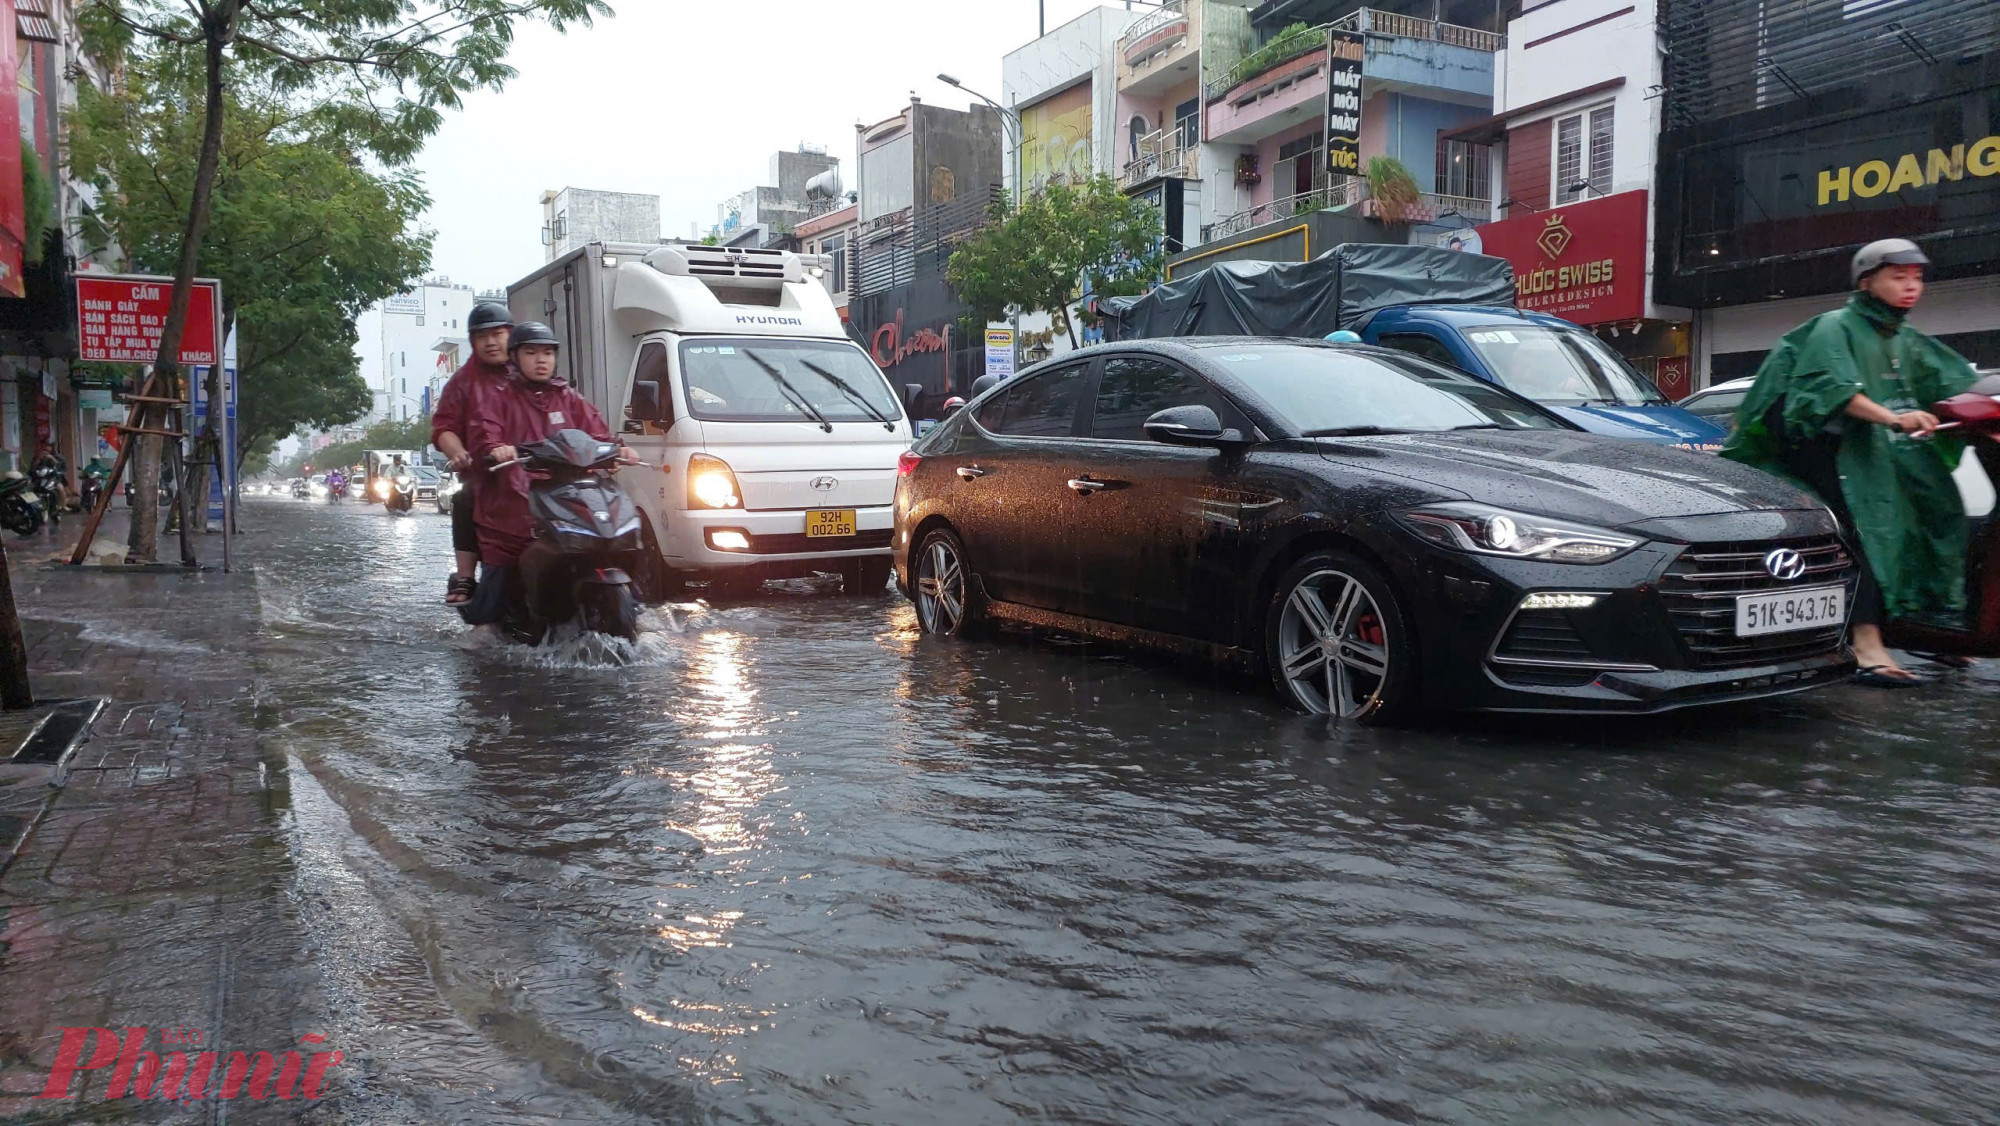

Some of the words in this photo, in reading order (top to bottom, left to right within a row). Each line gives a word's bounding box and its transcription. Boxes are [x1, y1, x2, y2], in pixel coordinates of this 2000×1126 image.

[1333, 65, 1361, 88] MẮT
[1333, 91, 1359, 111] MÔI
[1331, 112, 1359, 132] MÀY
[1330, 146, 1357, 169] TÓC
[1817, 136, 2000, 206] HOANG
[1559, 259, 1613, 288] SWISS
[132, 283, 160, 300] CẤM
[111, 313, 135, 324] SÁCH
[140, 314, 158, 325] BÁO
[736, 316, 802, 325] HYUNDAI
[111, 325, 138, 336] HÀNG
[143, 327, 164, 337] RON
[126, 338, 147, 348] MUA
[182, 351, 211, 361] KHÁCH
[820, 511, 842, 523] 92H
[812, 523, 851, 535] 002.66
[1747, 595, 1837, 628] 51K-943.76
